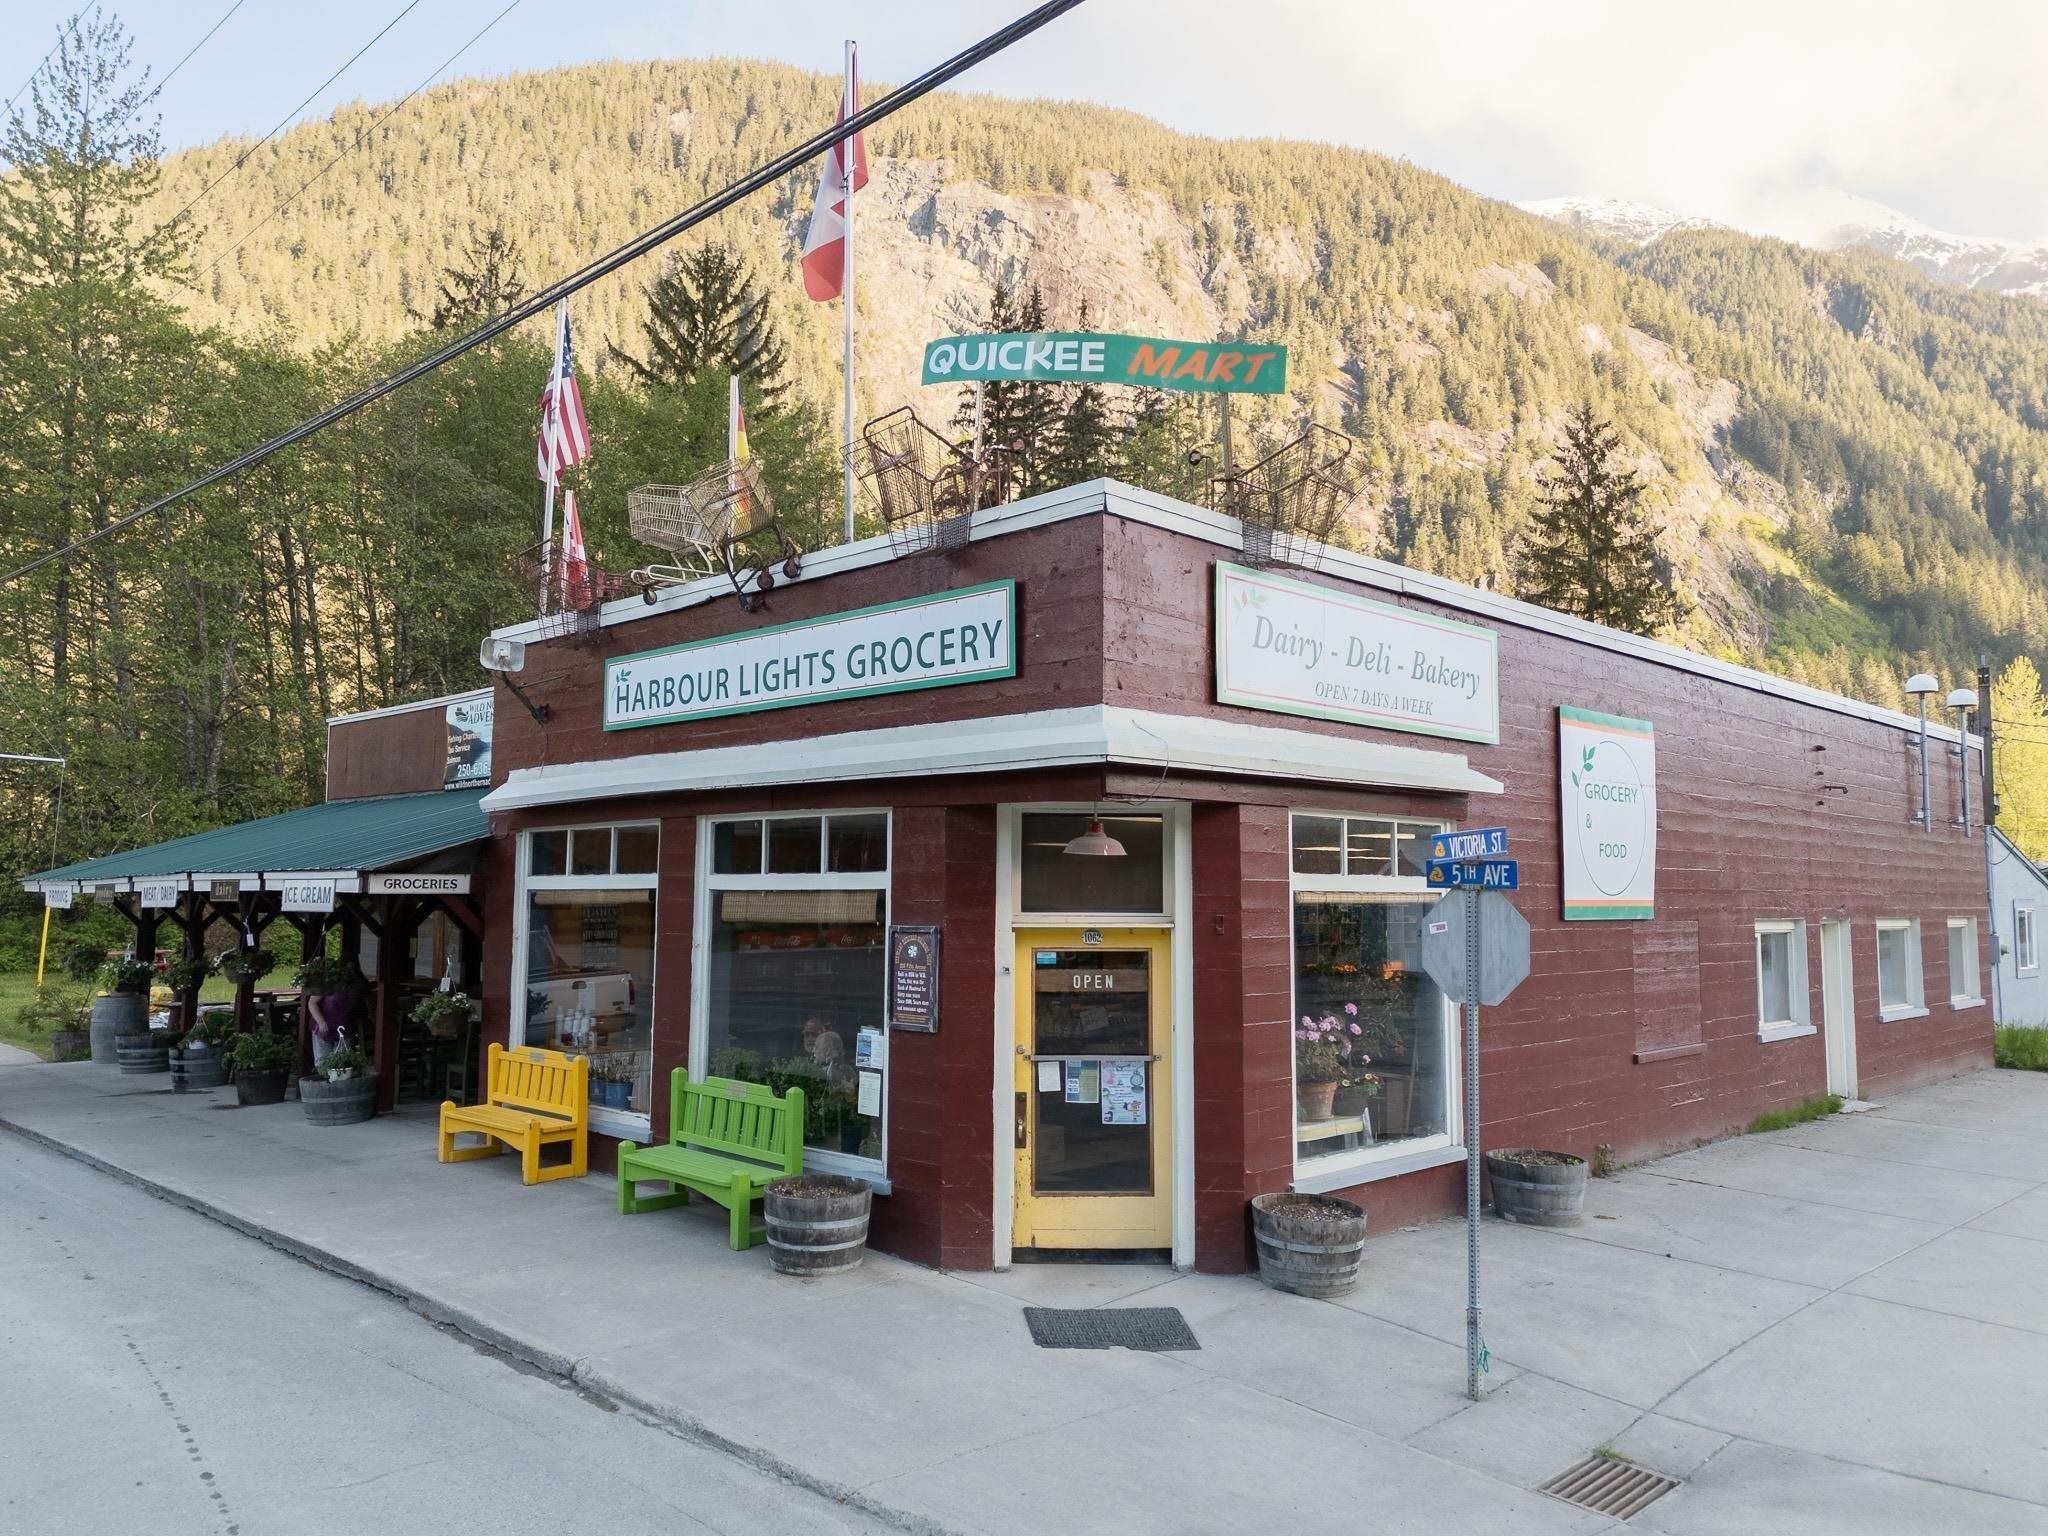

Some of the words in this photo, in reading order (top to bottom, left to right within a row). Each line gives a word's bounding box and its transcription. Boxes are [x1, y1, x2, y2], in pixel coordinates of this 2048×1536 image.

[928, 340, 1105, 376] QUICKEE
[1127, 344, 1276, 384] MART
[616, 667, 730, 714] HARBOUR
[740, 650, 835, 697] LIGHTS
[847, 619, 1003, 677] GROCERY
[1252, 615, 1325, 670] Dairy
[1345, 635, 1392, 675] Deli
[1410, 650, 1480, 700] Bakery
[1315, 681, 1349, 701] OPEN
[1352, 688, 1359, 703] 7
[1361, 690, 1390, 709] DAYS
[1390, 695, 1400, 710] A
[1401, 696, 1434, 716] WEEK
[1584, 782, 1638, 804] GROCERY
[1585, 813, 1593, 829] &
[1449, 834, 1487, 858] VICTORIA
[1491, 831, 1502, 853] ST
[1599, 842, 1628, 859] FOOD
[383, 878, 458, 890] GROCERIES
[1452, 864, 1477, 885] 5TH
[1483, 864, 1511, 886] AVE
[143, 886, 157, 901] MEAT
[160, 885, 176, 901] DAIRY
[284, 886, 298, 904] ICE
[301, 886, 332, 904] CREAM
[1084, 931, 1101, 943] 1062
[1073, 974, 1113, 989] OPEN
